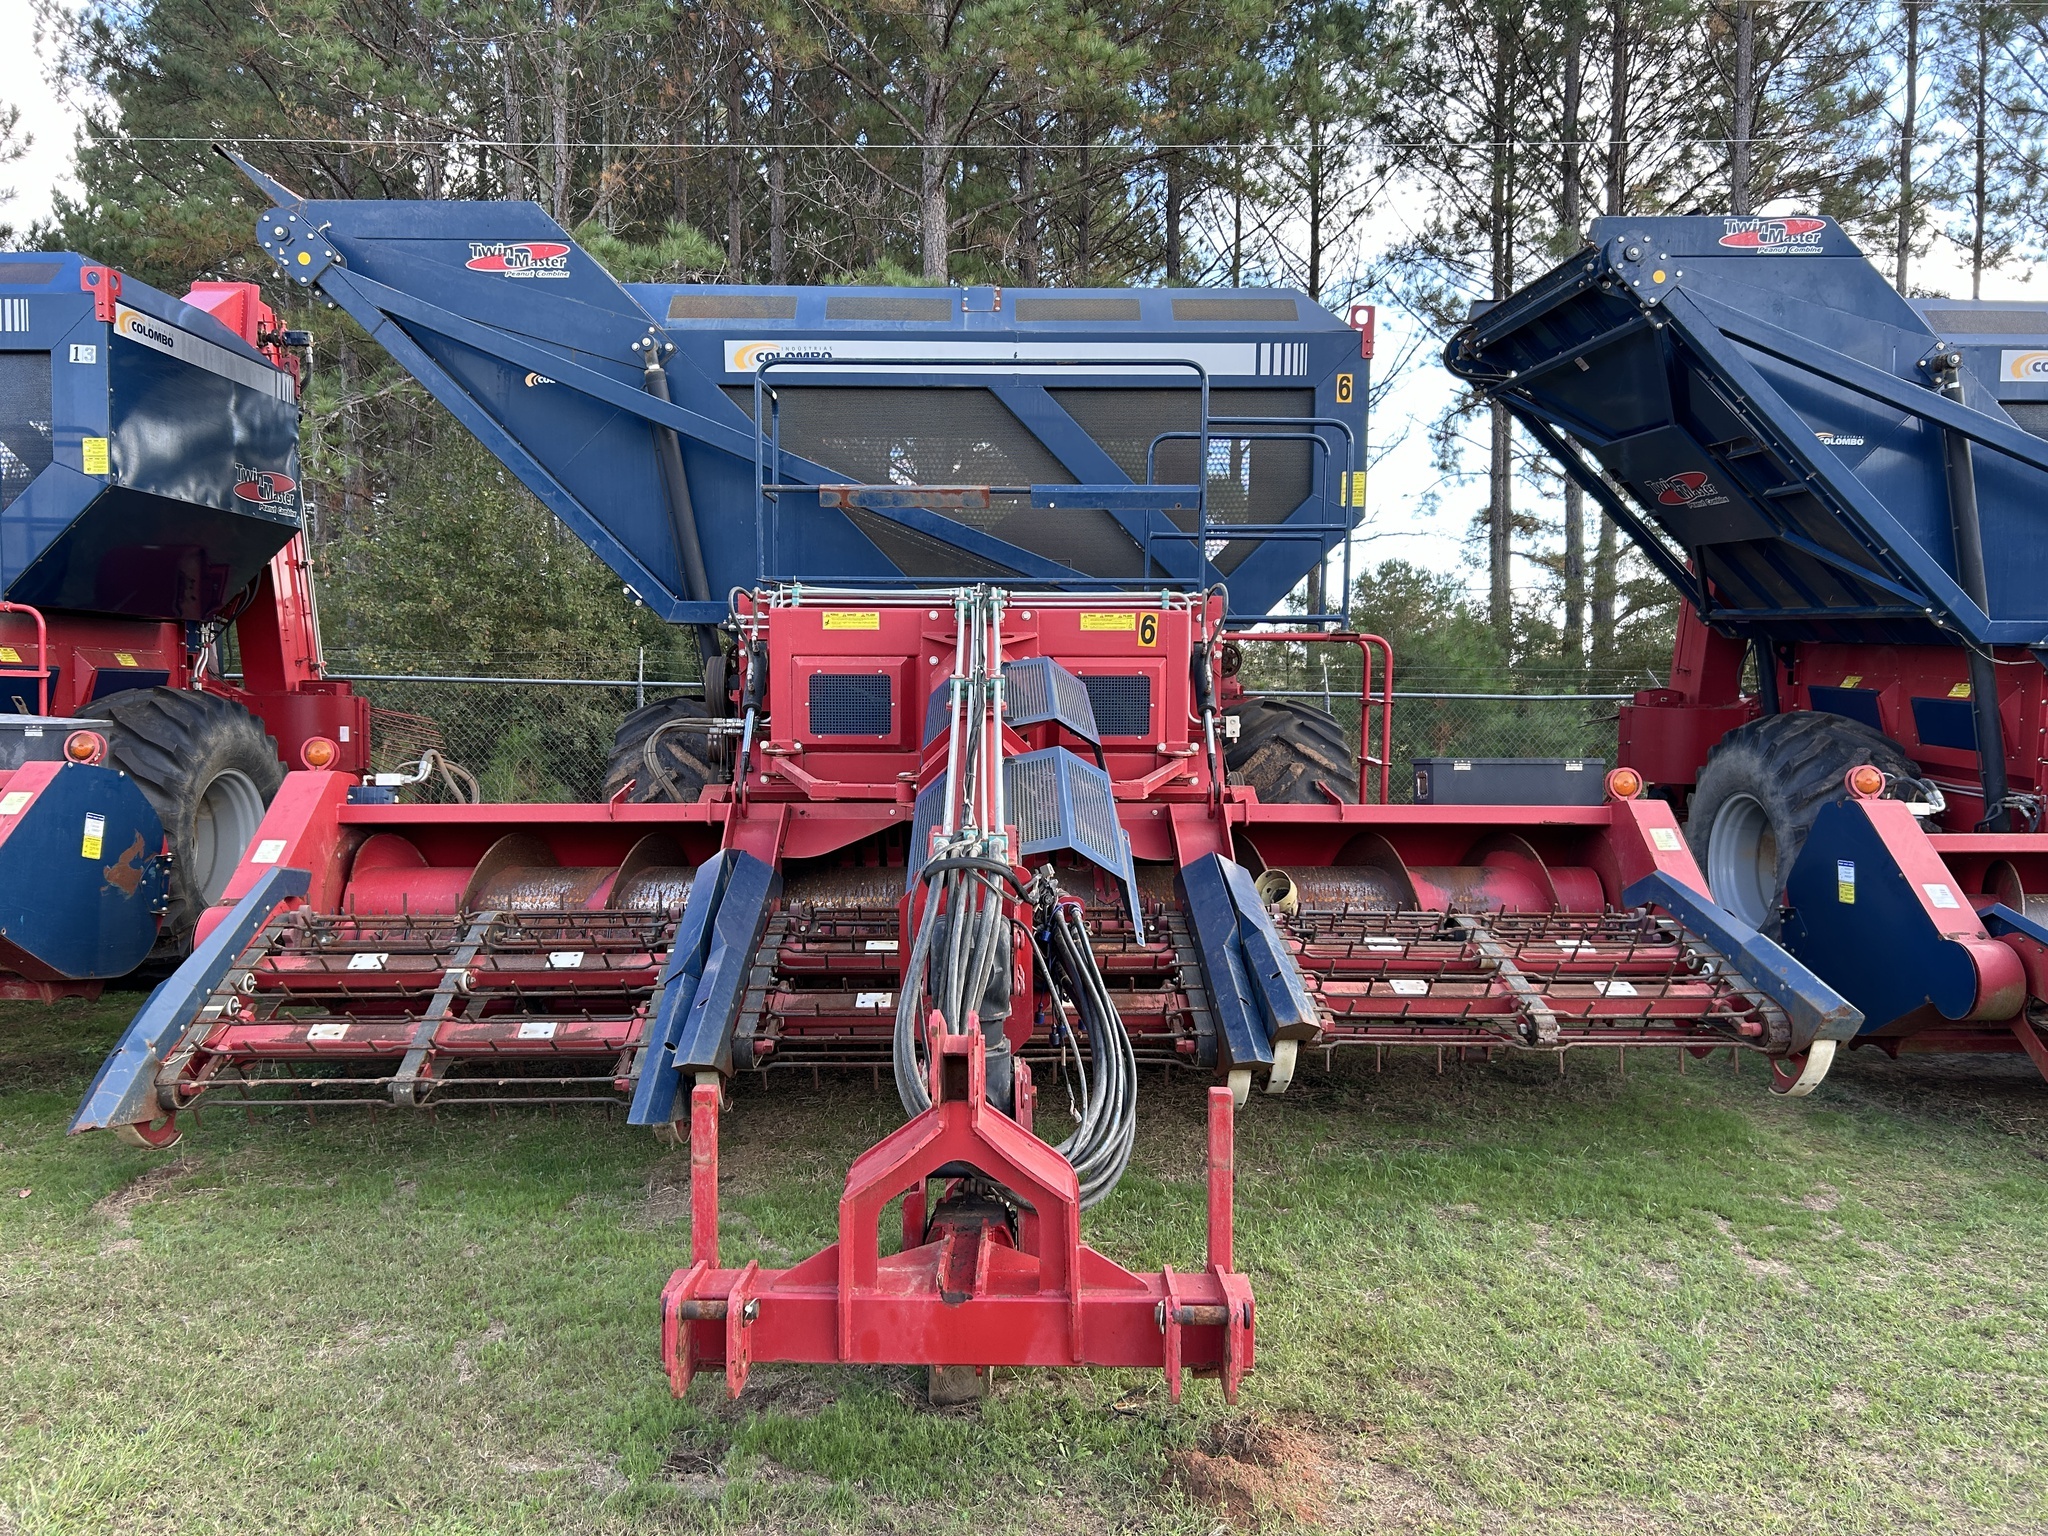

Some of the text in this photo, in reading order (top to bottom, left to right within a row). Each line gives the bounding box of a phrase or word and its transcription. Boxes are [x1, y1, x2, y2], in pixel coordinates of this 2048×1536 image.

[1724, 218, 1769, 234] Twin
[1767, 228, 1821, 244] Master
[469, 243, 514, 258] Twin
[514, 253, 567, 268] Master
[131, 321, 174, 348] COLOMBO
[1338, 375, 1351, 400] 6
[1140, 614, 1156, 645] 6
